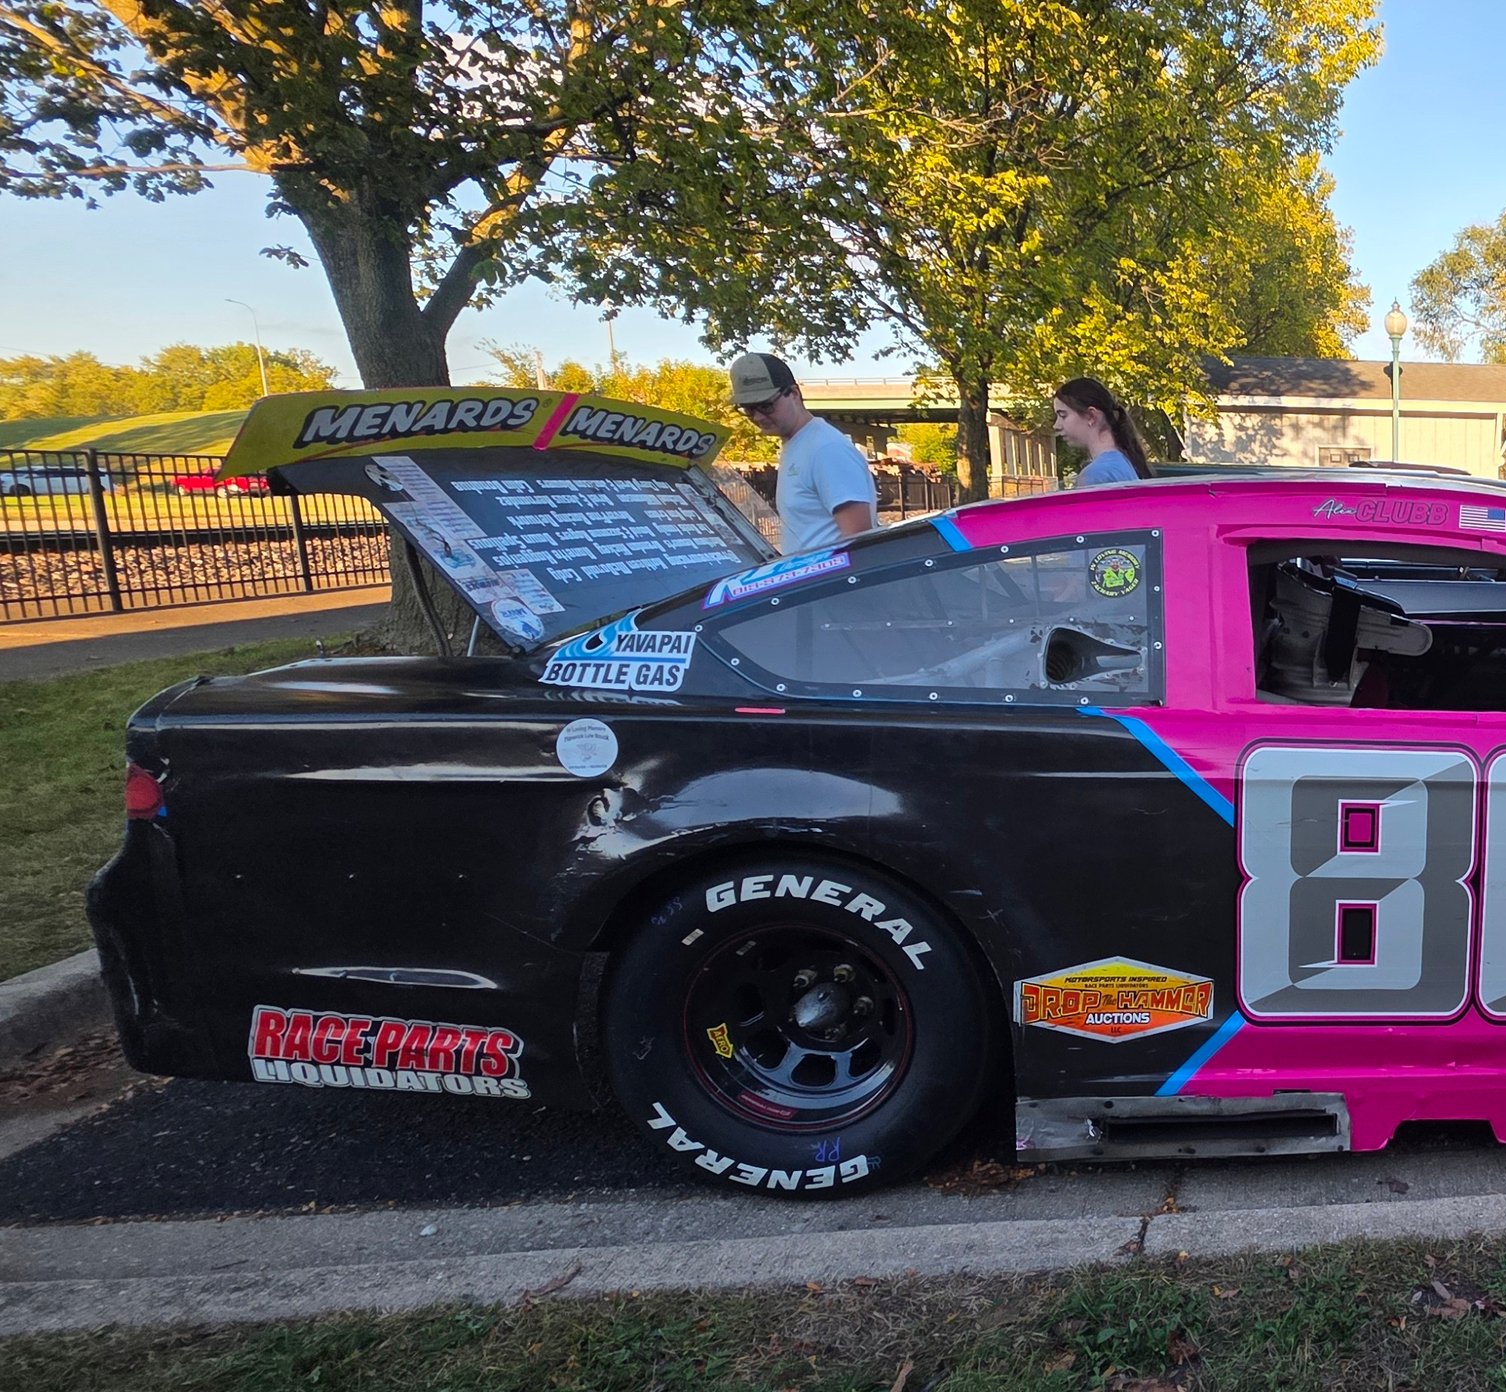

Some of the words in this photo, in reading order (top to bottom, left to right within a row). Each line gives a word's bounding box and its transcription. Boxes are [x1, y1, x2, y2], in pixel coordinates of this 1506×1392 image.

[299, 398, 540, 446] MENARDS
[564, 405, 717, 457] MENARDS
[1355, 500, 1448, 526] CLUBB
[615, 632, 692, 654] YAVAPAI
[545, 661, 629, 686] BOTTLE
[635, 662, 684, 687] GAS
[705, 874, 933, 970] GENERAL
[1022, 982, 1101, 1025] DROP
[1118, 982, 1213, 1017] HAMMER
[1085, 1012, 1151, 1025] AUCTIONS
[254, 1009, 372, 1065] RACE
[372, 1020, 515, 1077] PARTS
[713, 1030, 729, 1053] AERO
[252, 1059, 530, 1098] LIQUIDATORS
[646, 1101, 870, 1190] GENERAL
